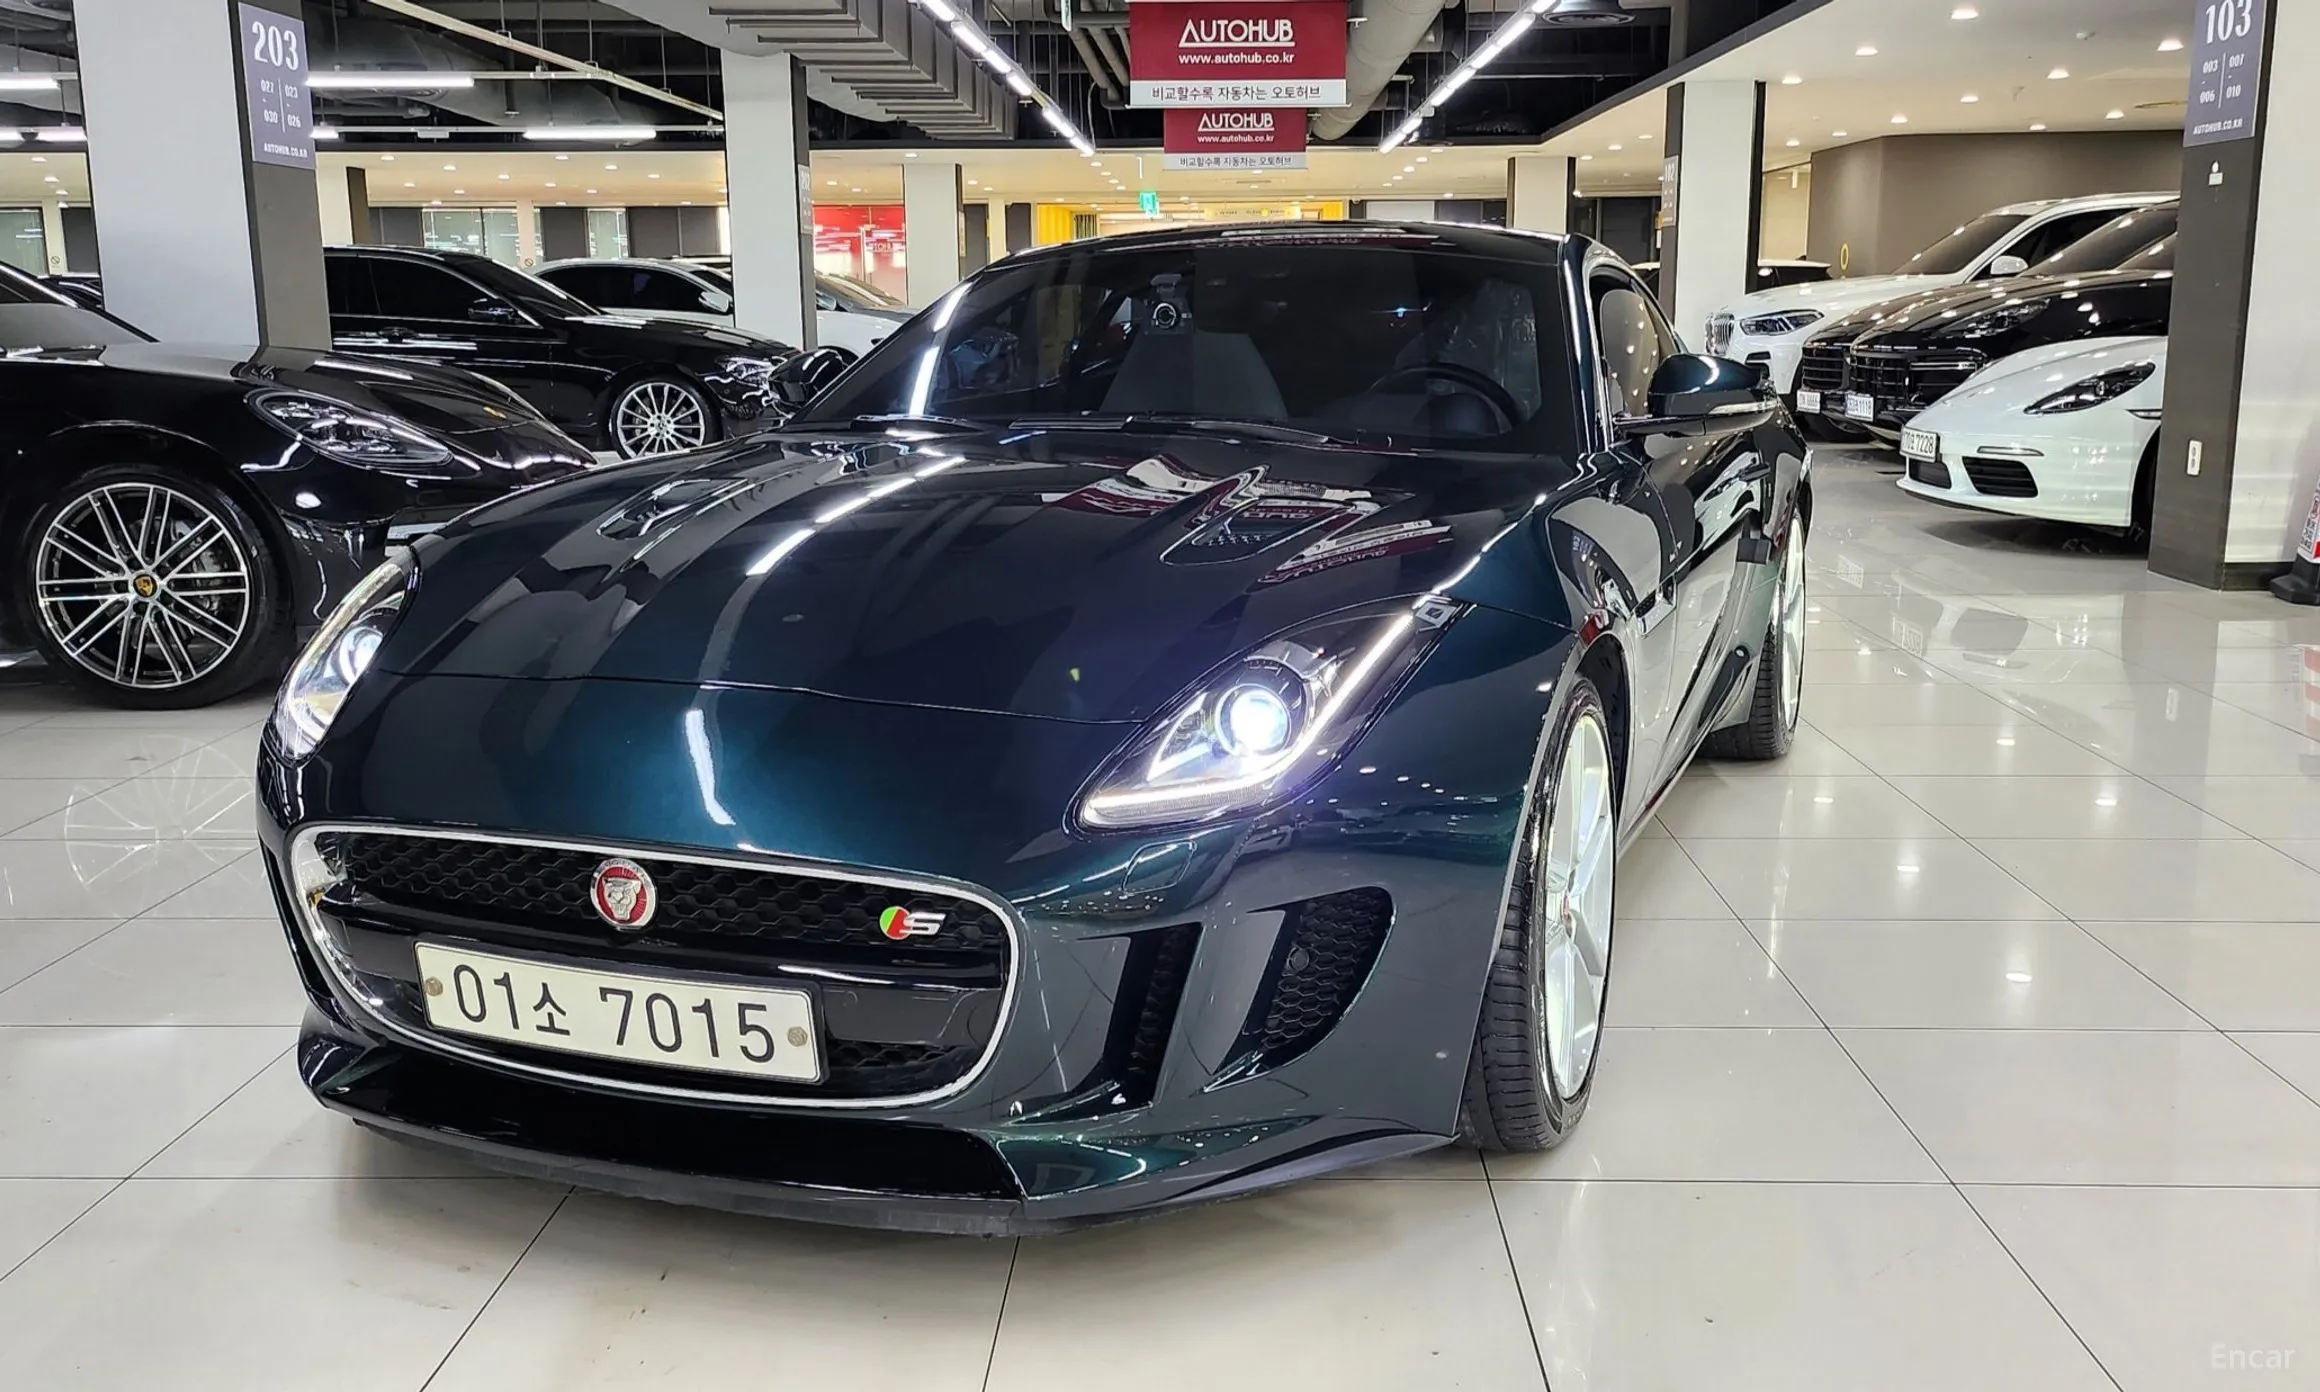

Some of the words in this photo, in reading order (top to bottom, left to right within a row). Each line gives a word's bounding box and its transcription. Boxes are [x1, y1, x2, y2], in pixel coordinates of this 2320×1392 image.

[2205, 0, 2253, 44] 103
[1178, 18, 1295, 47] AUTOHUB
[251, 21, 299, 71] 203
[1178, 51, 1295, 65] www.autohub.co.kr
[260, 79, 275, 94] 027
[284, 84, 298, 99] 023
[1152, 86, 1213, 101] 비교할수록
[1218, 86, 1268, 101] 자동차는
[1271, 86, 1321, 100] 오토허브
[2225, 84, 2242, 99] 010
[287, 114, 302, 129] 026
[1197, 112, 1275, 132] AUTOHUB
[2193, 118, 2243, 135] AUTOHUB.CO.KR
[1197, 134, 1275, 144] www.autohub.co.kr
[1180, 157, 1221, 167] 비교할수록
[1223, 157, 1256, 167] 자동차는
[1258, 157, 1292, 166] 오토허브
[453, 963, 571, 1037] 01소
[598, 986, 776, 1064] 7015
